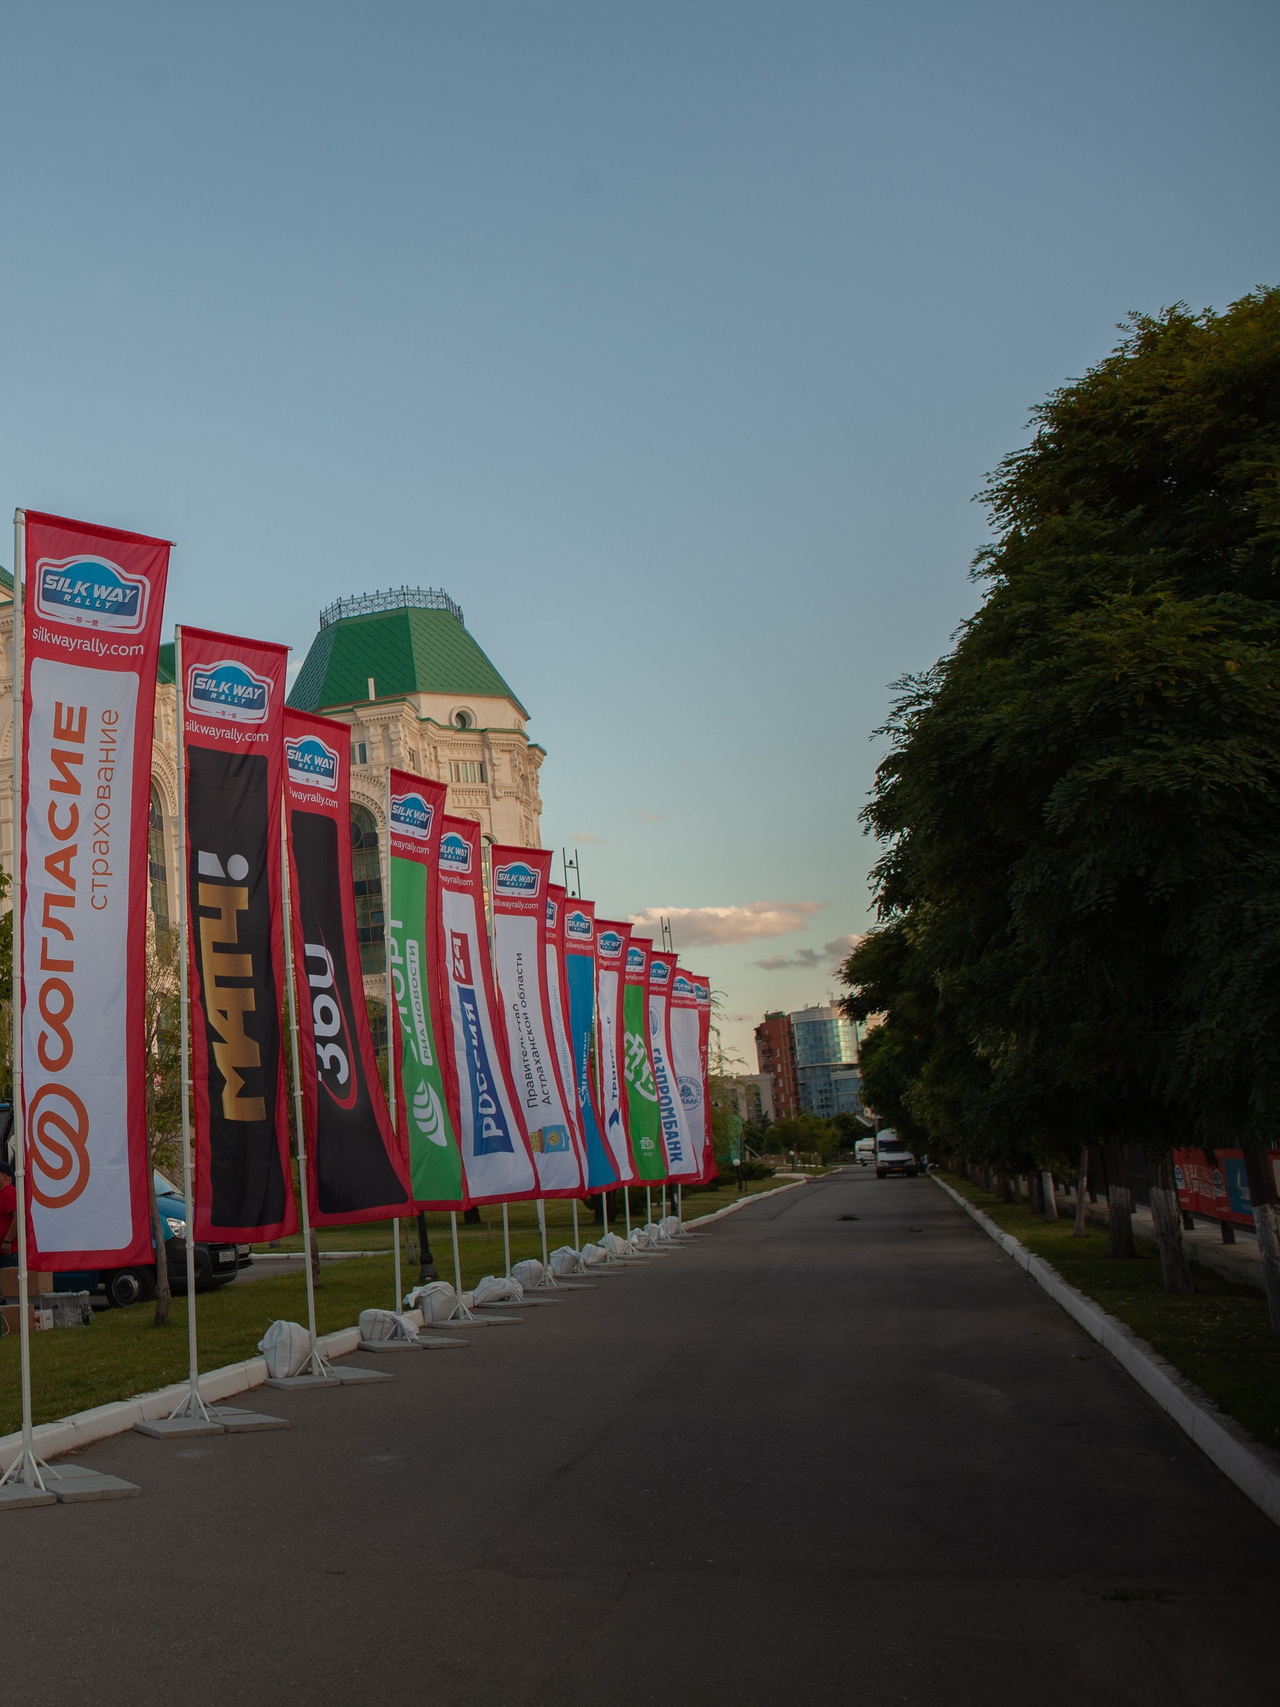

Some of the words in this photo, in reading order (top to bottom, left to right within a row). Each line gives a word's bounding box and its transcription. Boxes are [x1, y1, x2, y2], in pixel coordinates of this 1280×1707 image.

[43, 574, 92, 597] SILK
[93, 583, 138, 604] WAY
[63, 594, 113, 610] RALLY
[32, 626, 144, 657] silkwayrally.com
[194, 677, 232, 694] SILK
[232, 684, 264, 700] WAY
[210, 692, 247, 705] RALLY
[185, 720, 269, 744] silkwayrally.com
[286, 749, 313, 764] SILK
[313, 754, 335, 770] WAY
[90, 708, 120, 911] страхование
[391, 804, 414, 818] SILK
[414, 810, 430, 822] WAY
[37, 700, 88, 1073] СОГЛАСИЕ
[498, 873, 519, 882] SILK
[519, 875, 536, 884] WAY
[198, 850, 267, 1122] МАТЧ!
[408, 945, 424, 1024] НОВОСТИ
[516, 952, 526, 1009] области
[419, 1028, 431, 1060] РИА
[520, 1012, 552, 1106] Астраханской
[607, 1016, 618, 1101] ТРИКО
[653, 1048, 683, 1163] ГАЗПРОМБАНК
